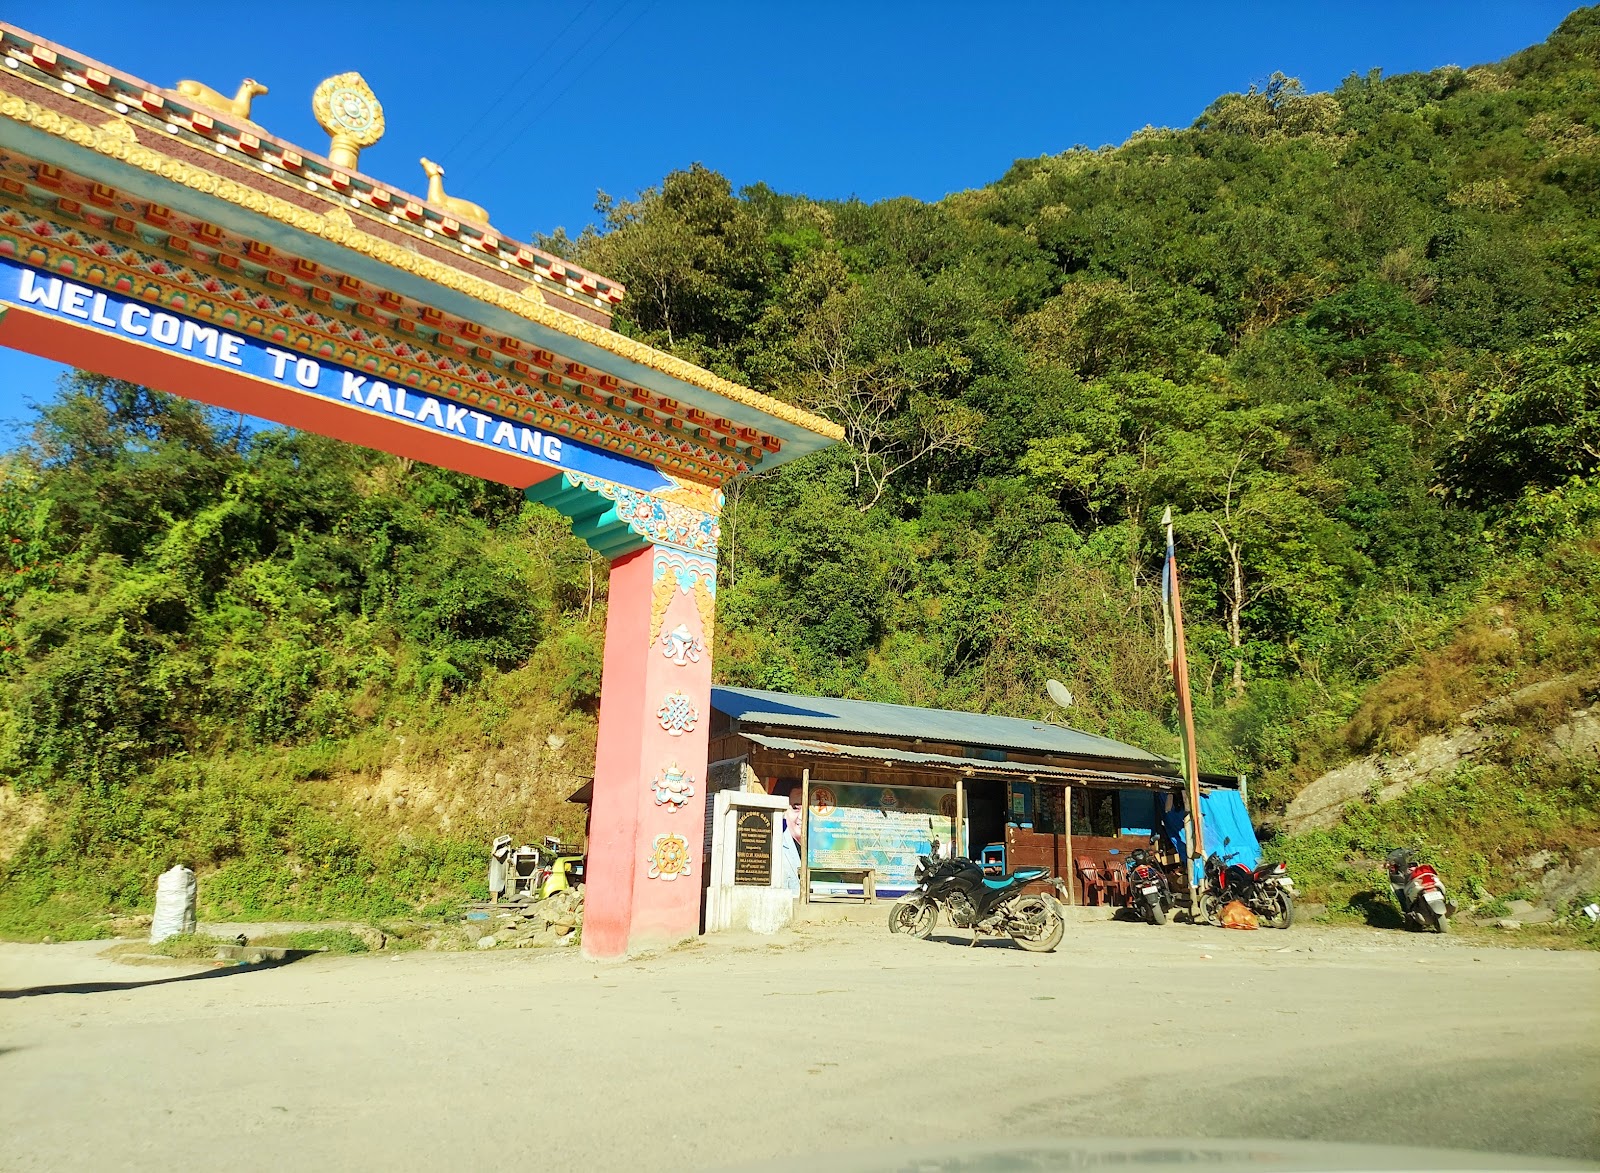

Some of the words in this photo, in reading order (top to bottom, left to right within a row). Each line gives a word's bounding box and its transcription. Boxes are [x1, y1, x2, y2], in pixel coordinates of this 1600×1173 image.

[18, 268, 246, 366] WELCOME
[266, 347, 321, 388] TO
[341, 371, 562, 462] KALAKTANG
[738, 811, 760, 825] WELCOME
[760, 813, 771, 828] GATE
